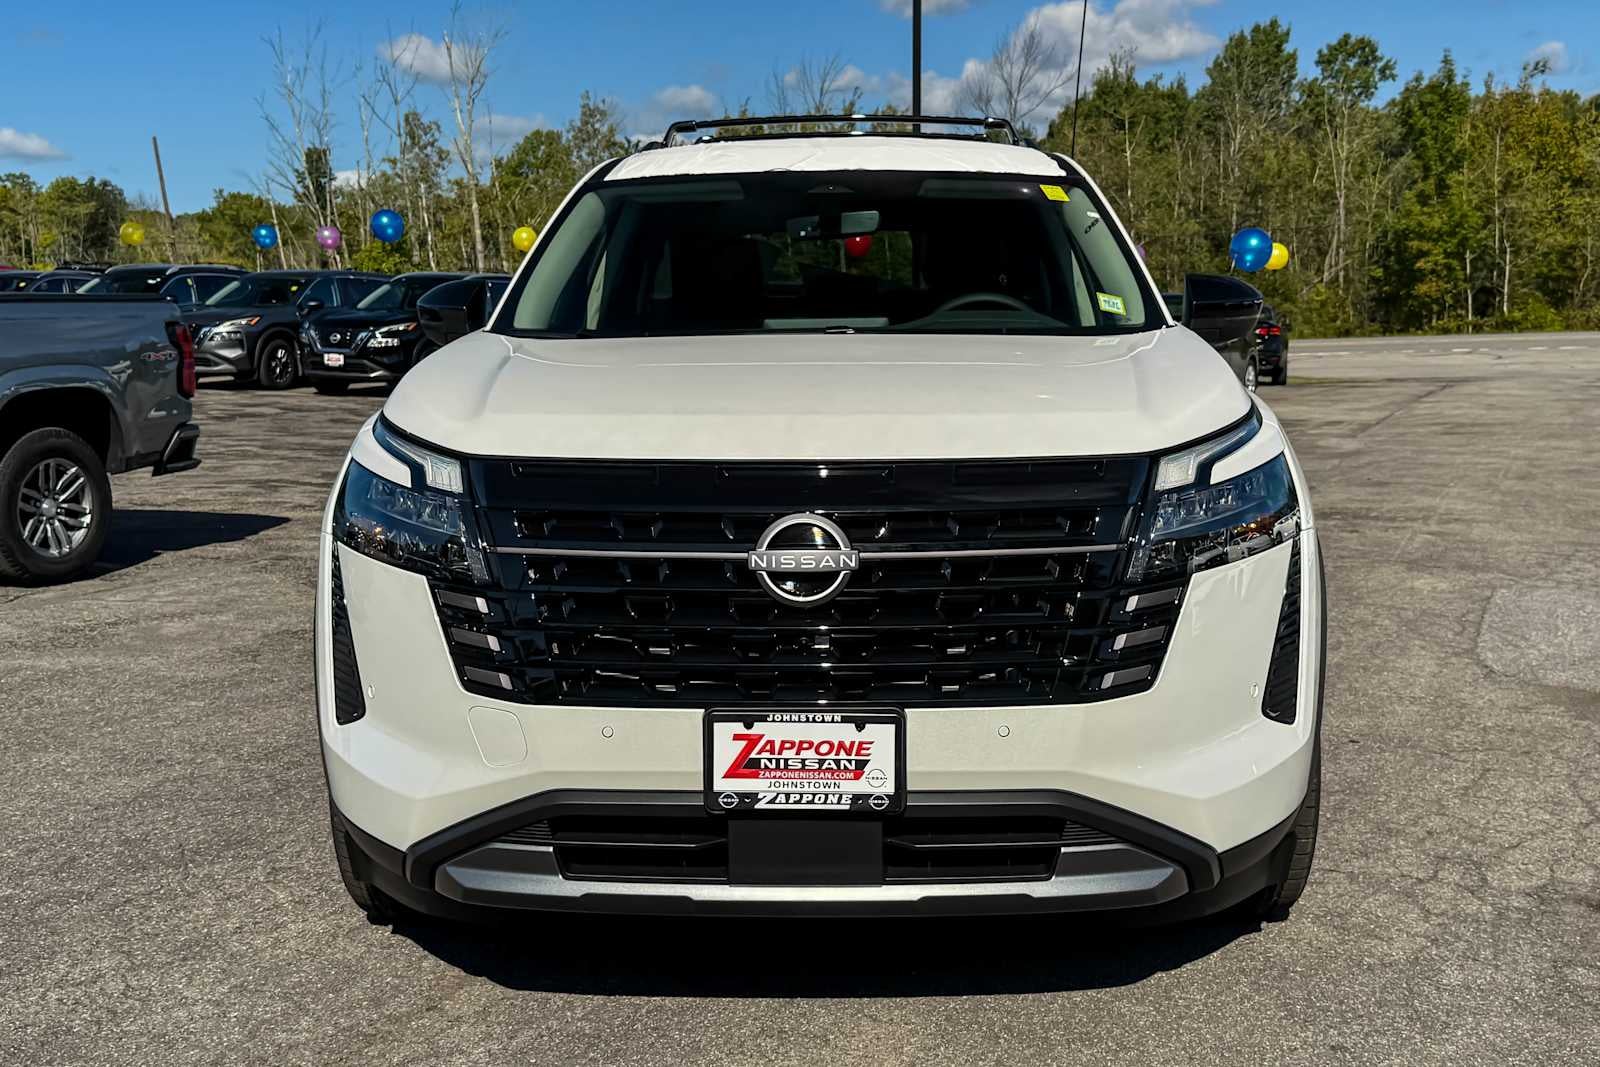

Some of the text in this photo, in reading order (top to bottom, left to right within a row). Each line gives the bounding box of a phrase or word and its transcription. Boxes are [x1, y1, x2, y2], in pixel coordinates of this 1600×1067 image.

[751, 554, 856, 568] NISSAN
[767, 714, 842, 722] JOHNSTOWN
[722, 733, 875, 779] ZAPPONE
[760, 759, 856, 769] NISSAN
[758, 770, 854, 780] ZAPPONENISSAN.COM
[767, 781, 841, 789] JOHNSTOWN
[754, 792, 853, 809] ZAPPONE
